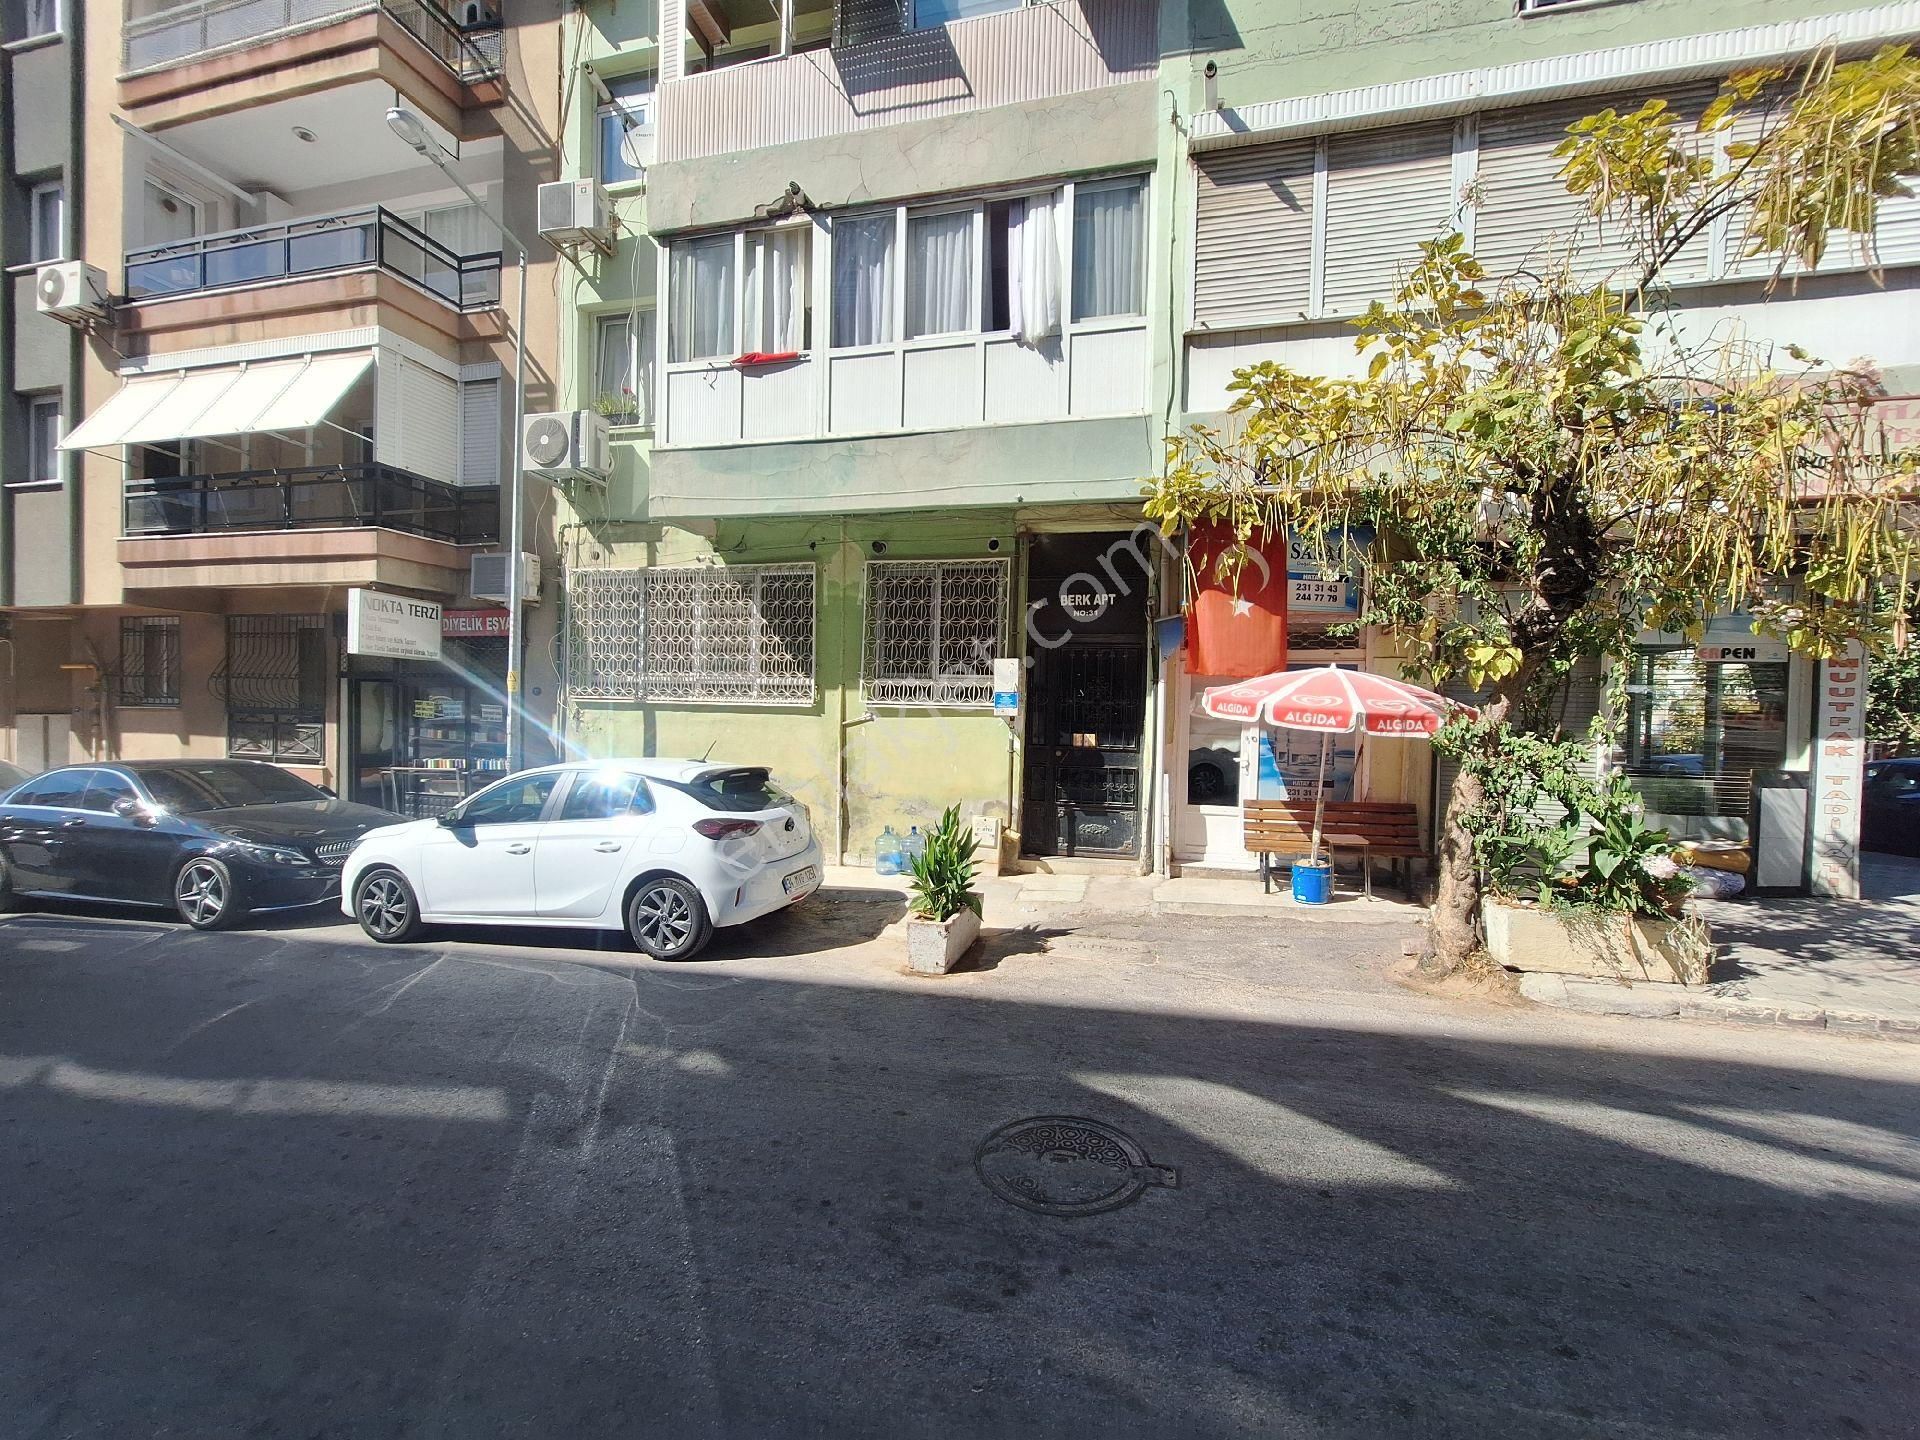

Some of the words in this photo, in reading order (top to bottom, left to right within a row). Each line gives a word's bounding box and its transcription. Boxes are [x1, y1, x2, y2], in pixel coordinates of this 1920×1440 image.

[1296, 583, 1311, 591] 231
[1315, 584, 1324, 592] 31
[1060, 594, 1091, 606] BERK
[1093, 593, 1116, 606] APT
[1295, 593, 1311, 601] 244
[1314, 594, 1325, 602] 77
[363, 597, 404, 615] NOKTA
[407, 603, 439, 620] TERZİ
